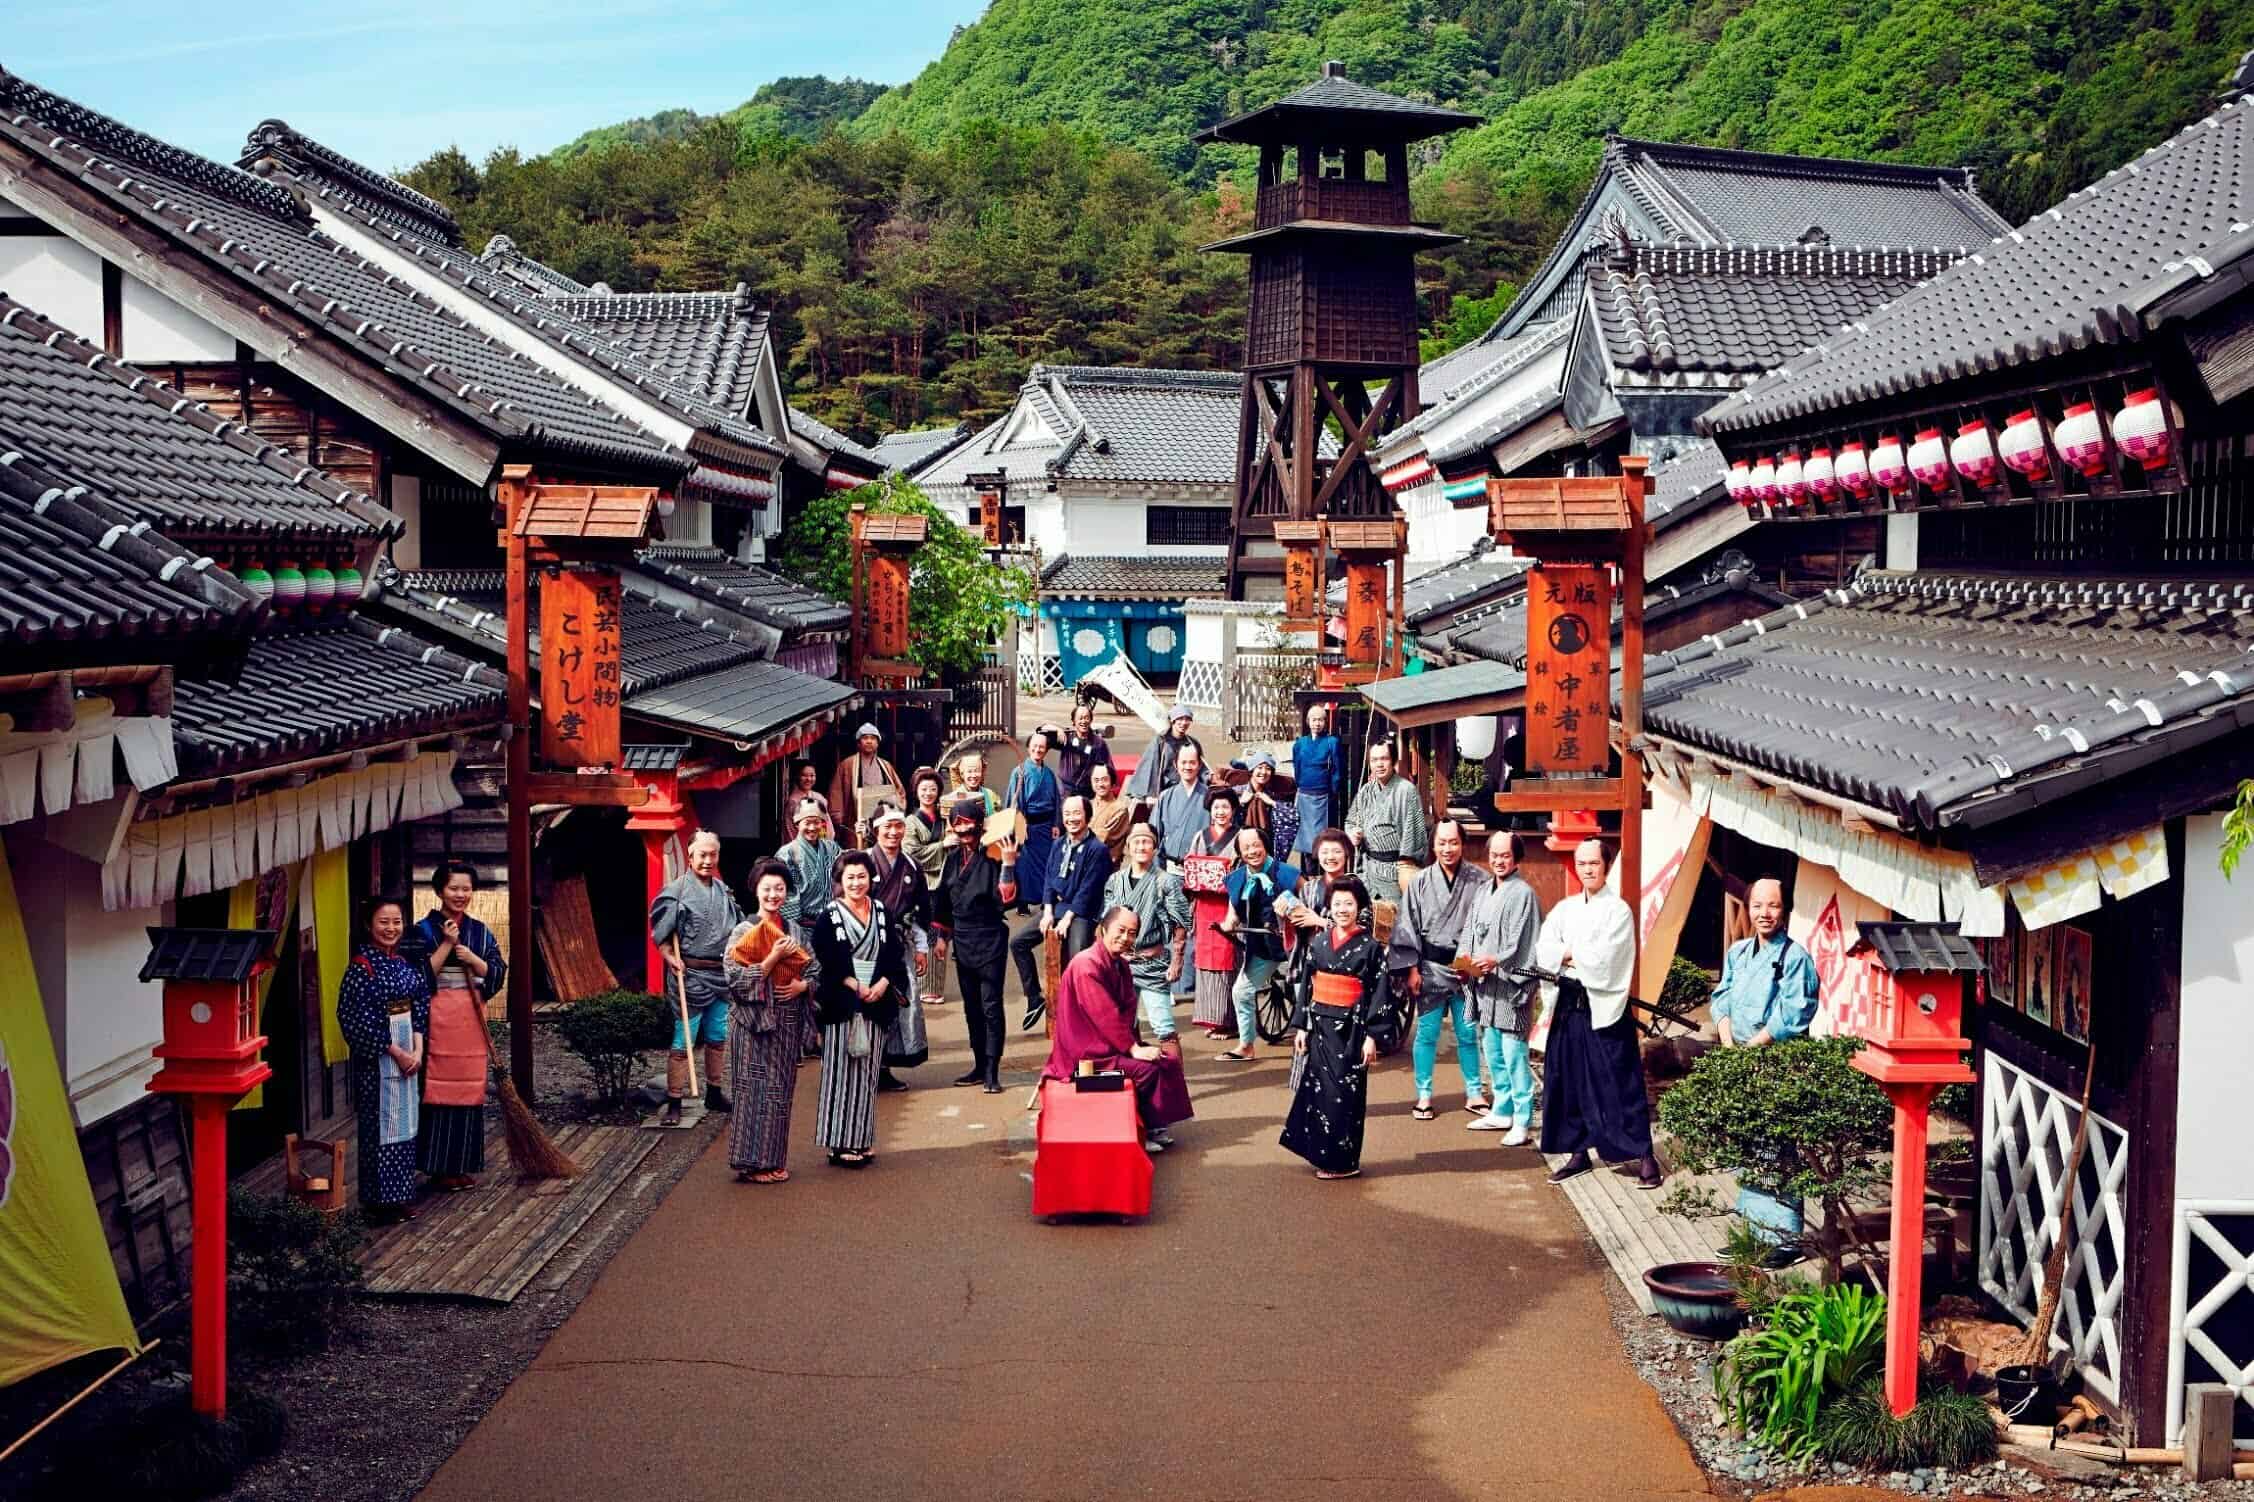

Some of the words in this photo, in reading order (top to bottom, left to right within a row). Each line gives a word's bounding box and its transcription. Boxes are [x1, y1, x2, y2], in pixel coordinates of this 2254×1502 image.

[556, 612, 586, 740] こけし堂
[593, 585, 618, 708] 民芸小間物
